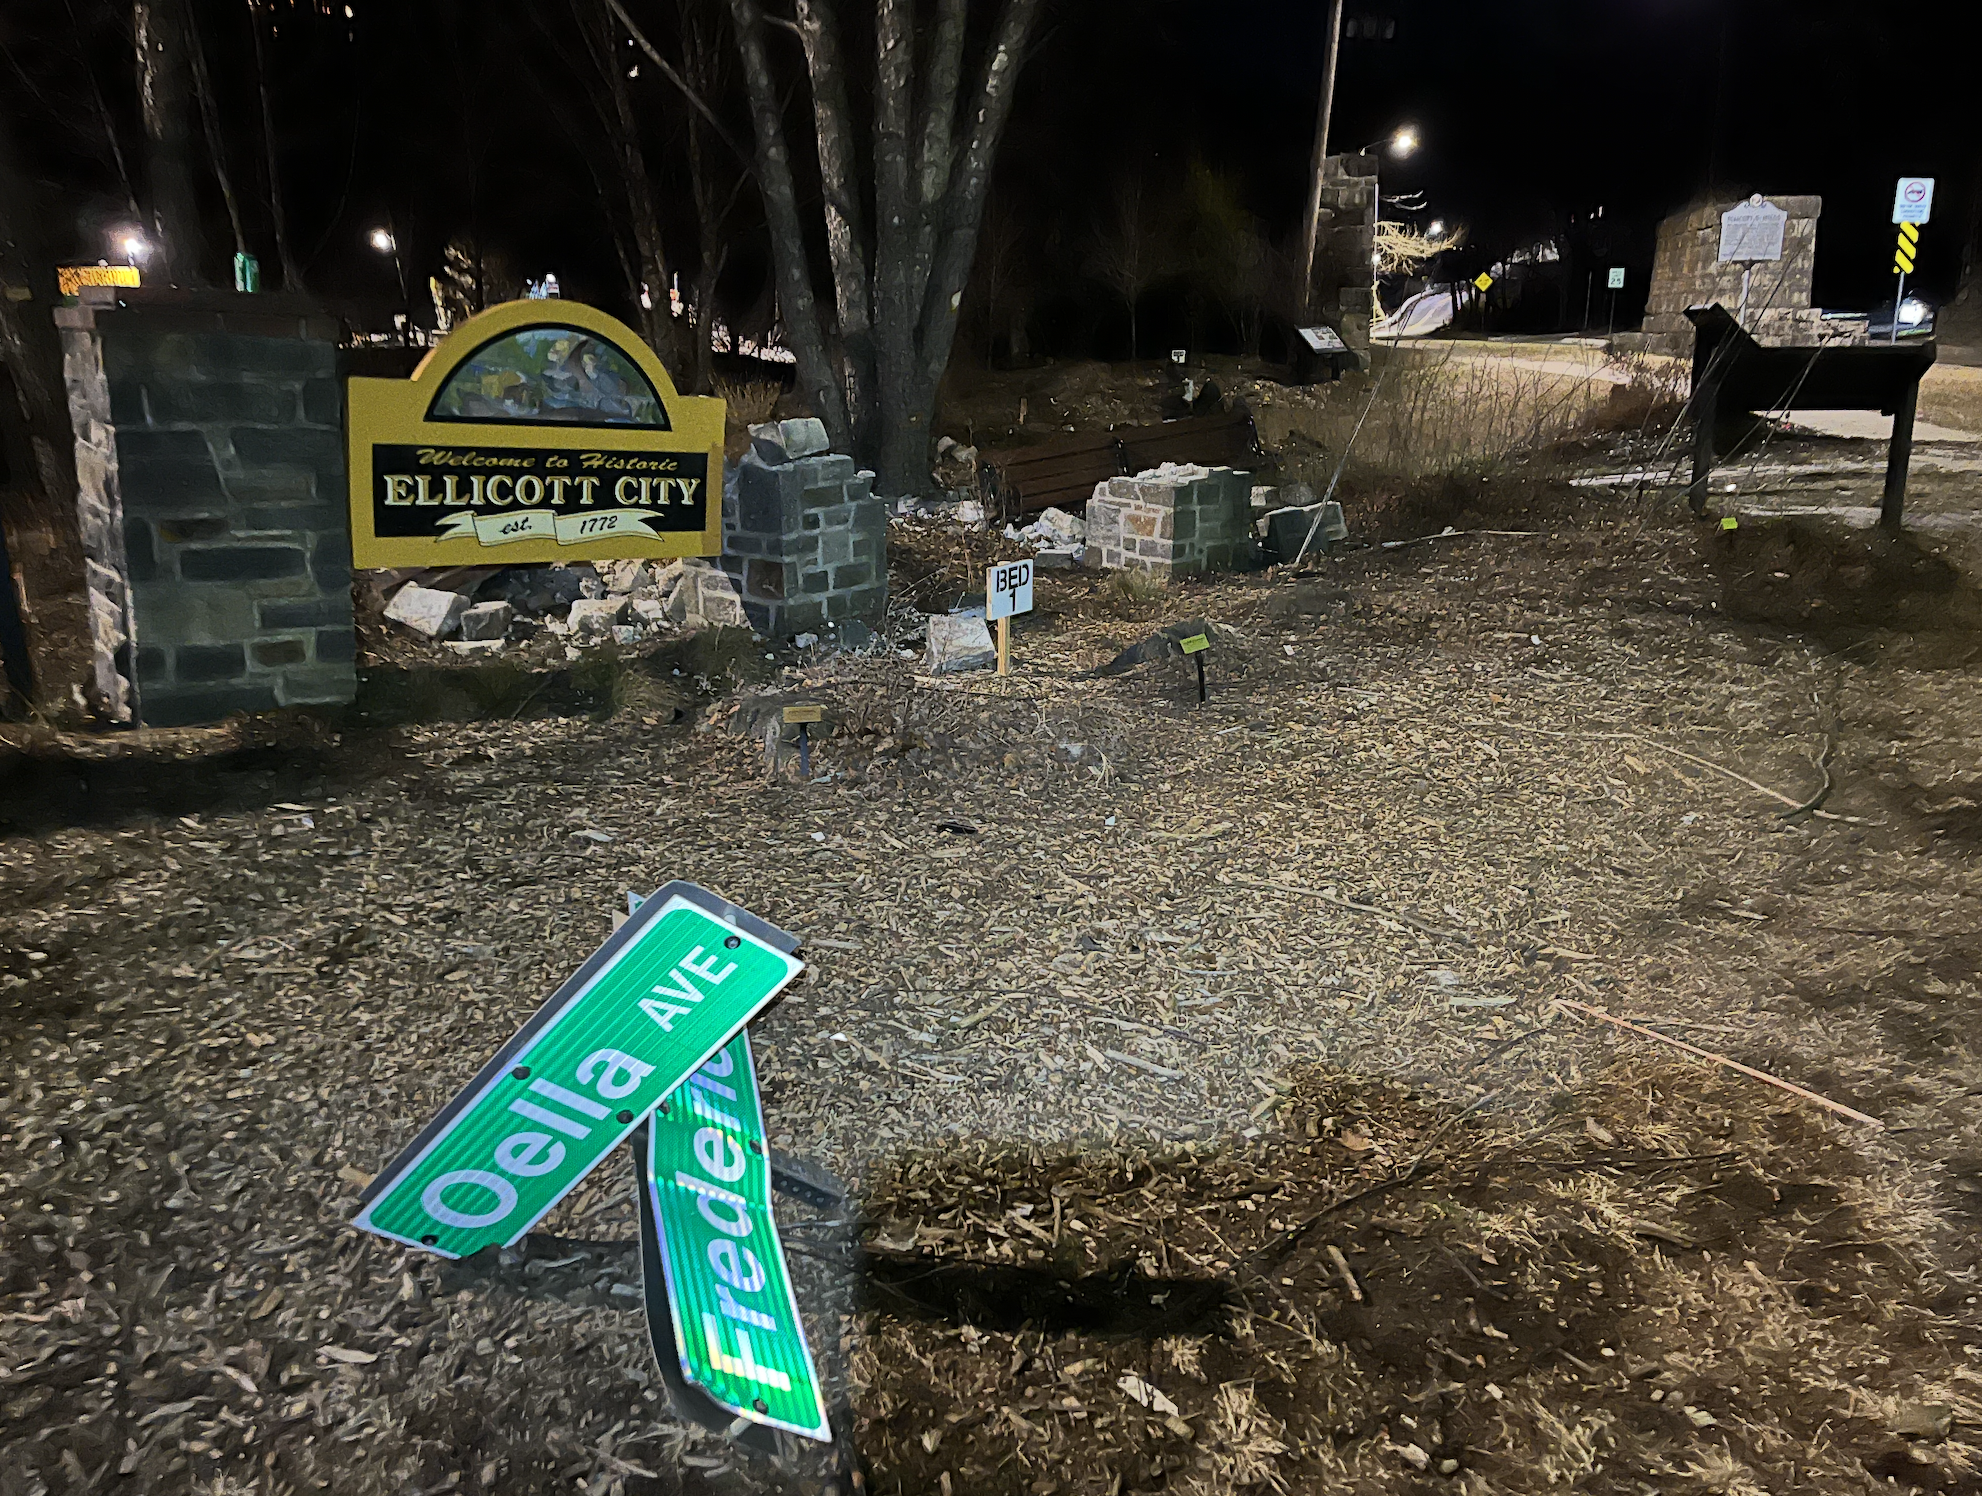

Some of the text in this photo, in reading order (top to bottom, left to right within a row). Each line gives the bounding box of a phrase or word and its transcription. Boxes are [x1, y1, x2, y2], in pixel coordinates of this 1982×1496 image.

[416, 448, 679, 471] Welcome to Historic
[383, 474, 701, 506] ELLICOTT CITY
[499, 515, 618, 535] est. 1772
[996, 563, 1030, 593] BED
[1009, 588, 1016, 612] 1
[420, 943, 739, 1230] Oella AVE
